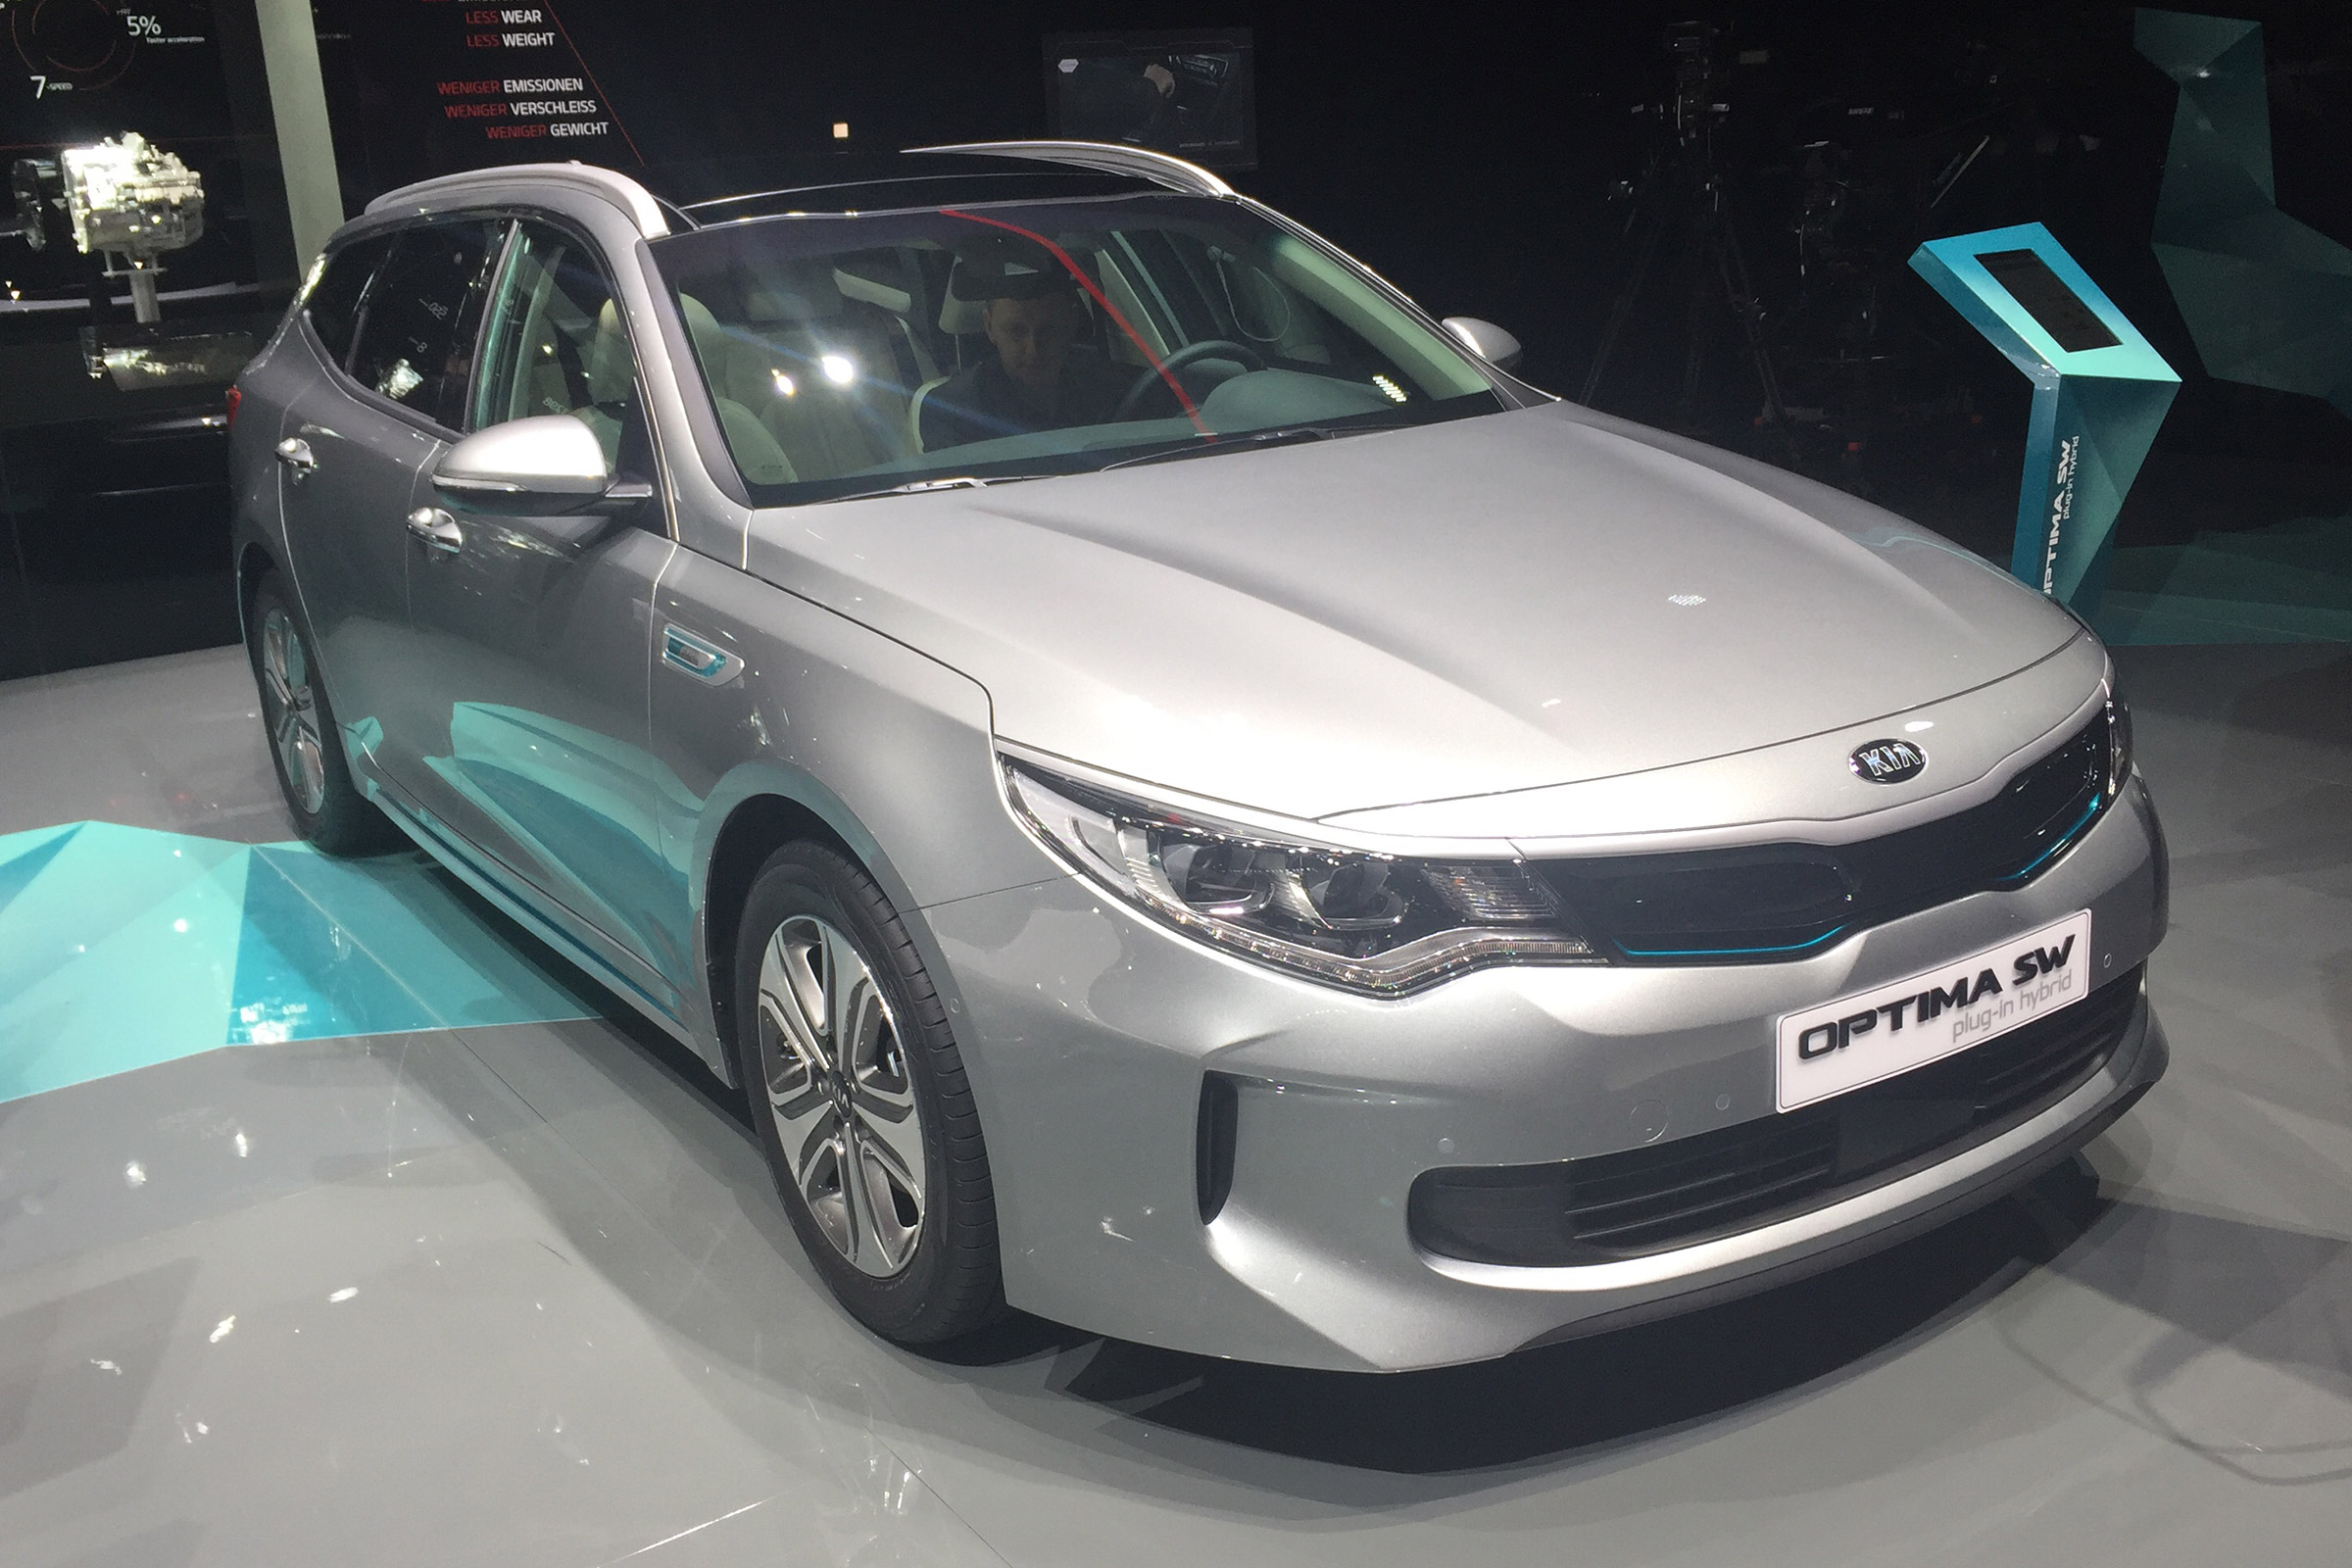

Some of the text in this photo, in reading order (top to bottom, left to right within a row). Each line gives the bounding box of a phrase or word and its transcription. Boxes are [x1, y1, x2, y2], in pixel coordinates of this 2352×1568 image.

[126, 16, 162, 36] 5%
[465, 9, 542, 24] LESS WEAR
[466, 32, 556, 48] LESS WEIGHT
[436, 78, 584, 95] WENIGER EMISSIONEN
[444, 100, 597, 119] WENIGER VERSCHLEISS
[485, 122, 609, 139] WENIGER GEWICHT
[2057, 440, 2072, 484] SW
[2063, 436, 2080, 519] plug-in hybrid
[1858, 743, 1922, 776] KIA
[1797, 933, 2077, 1060] OPTIMA SW
[1952, 968, 2073, 1043] plug-in hybrid
